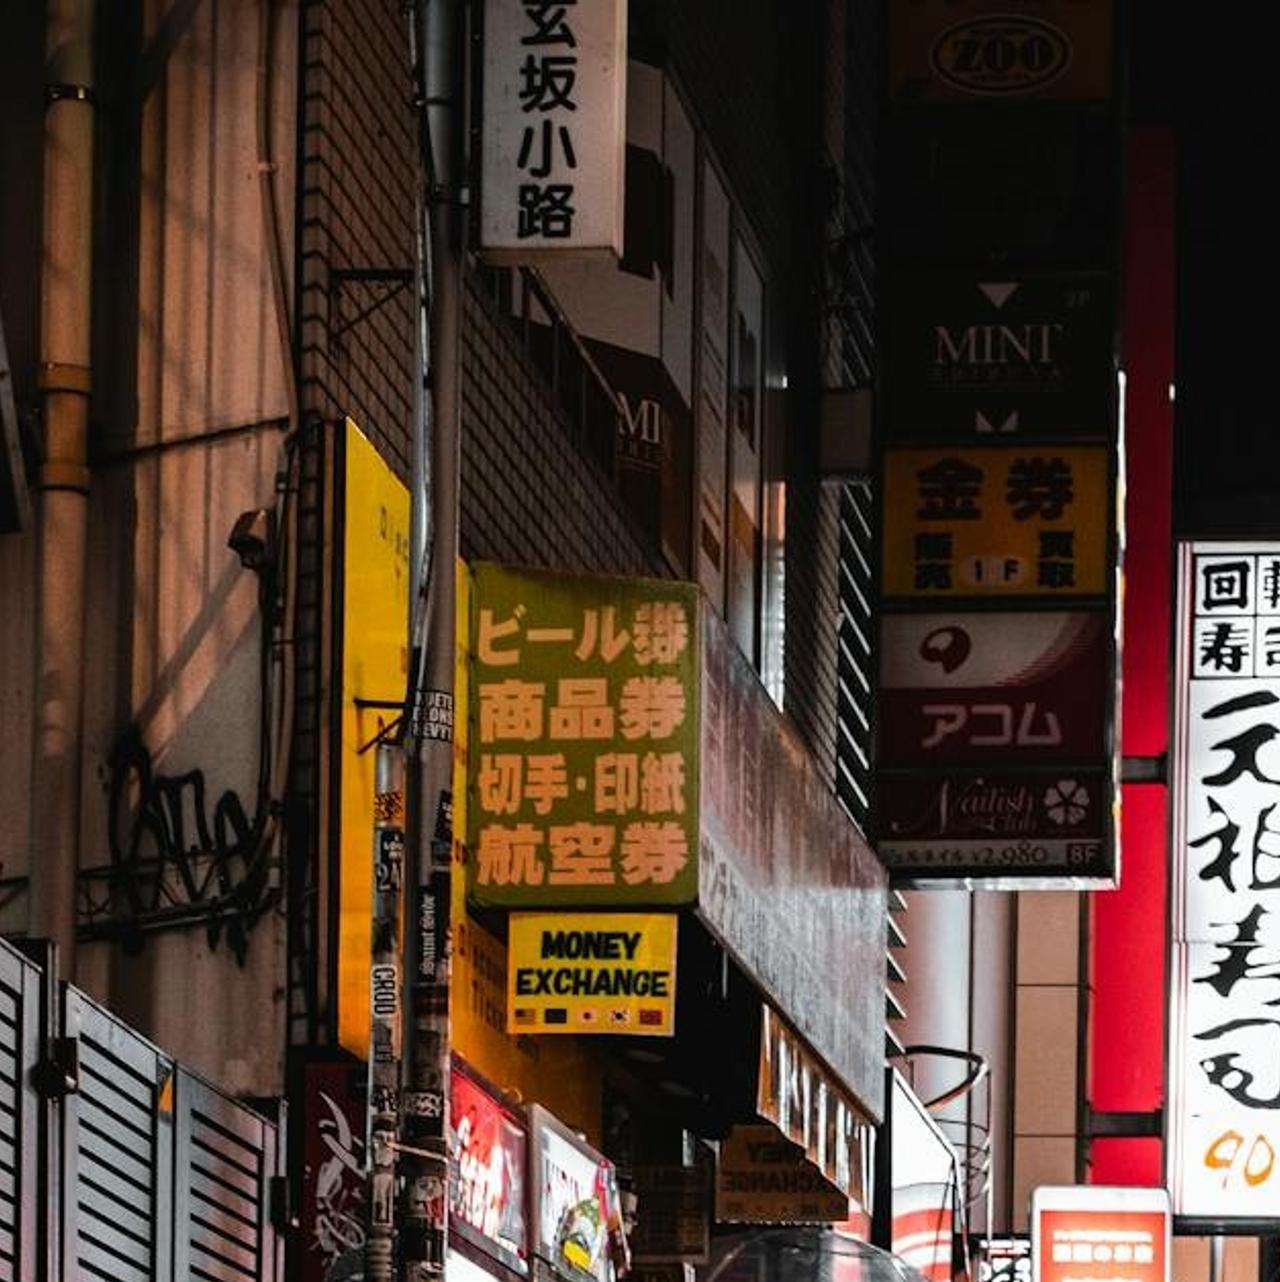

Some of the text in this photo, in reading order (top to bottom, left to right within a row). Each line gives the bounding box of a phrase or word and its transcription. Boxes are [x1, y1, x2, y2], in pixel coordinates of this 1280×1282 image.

[517, 0, 577, 239] 玄坂小路
[933, 323, 1064, 364] MINT
[477, 676, 687, 743] 商品券
[922, 702, 1063, 750] アコム
[476, 821, 689, 887] 航空券
[1069, 845, 1099, 864] 8F
[540, 931, 642, 960] MONEY
[516, 968, 670, 998] EXCHANGE
